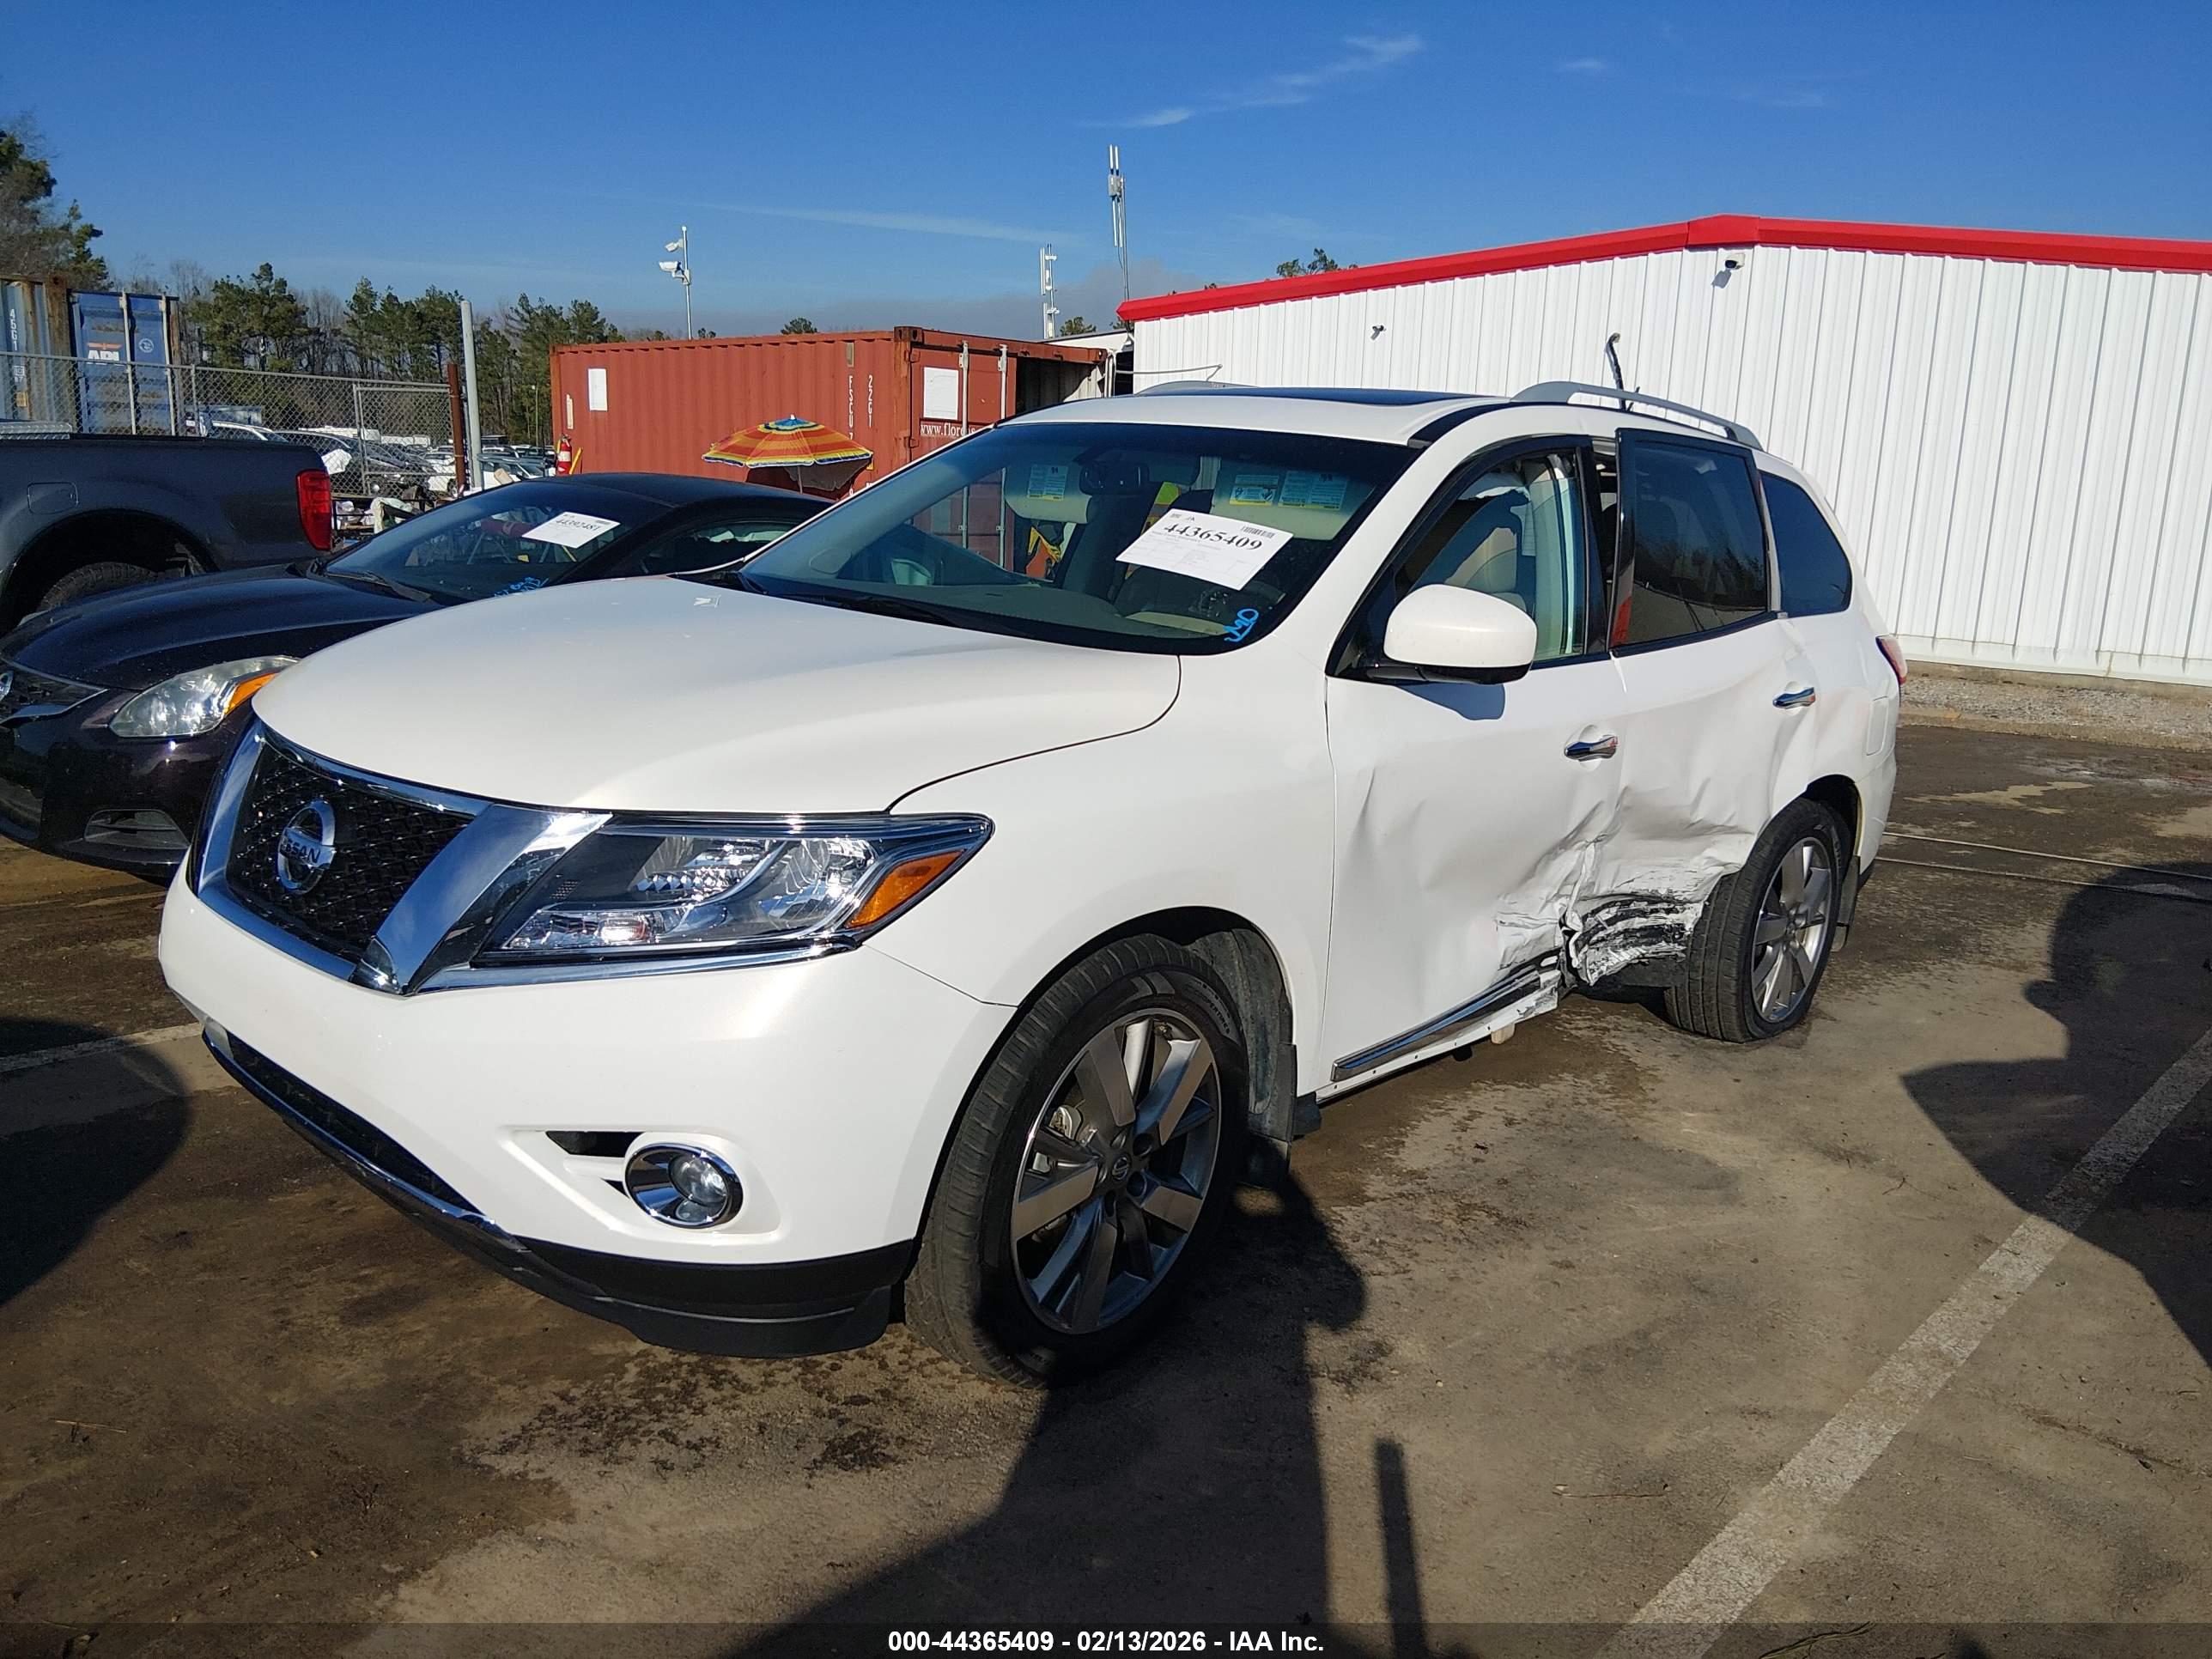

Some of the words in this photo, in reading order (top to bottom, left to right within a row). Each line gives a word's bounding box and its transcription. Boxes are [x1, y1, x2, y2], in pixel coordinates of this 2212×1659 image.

[9, 308, 18, 351] 45G1
[920, 422, 976, 437] www.flors
[1164, 523, 1263, 550] 44365409
